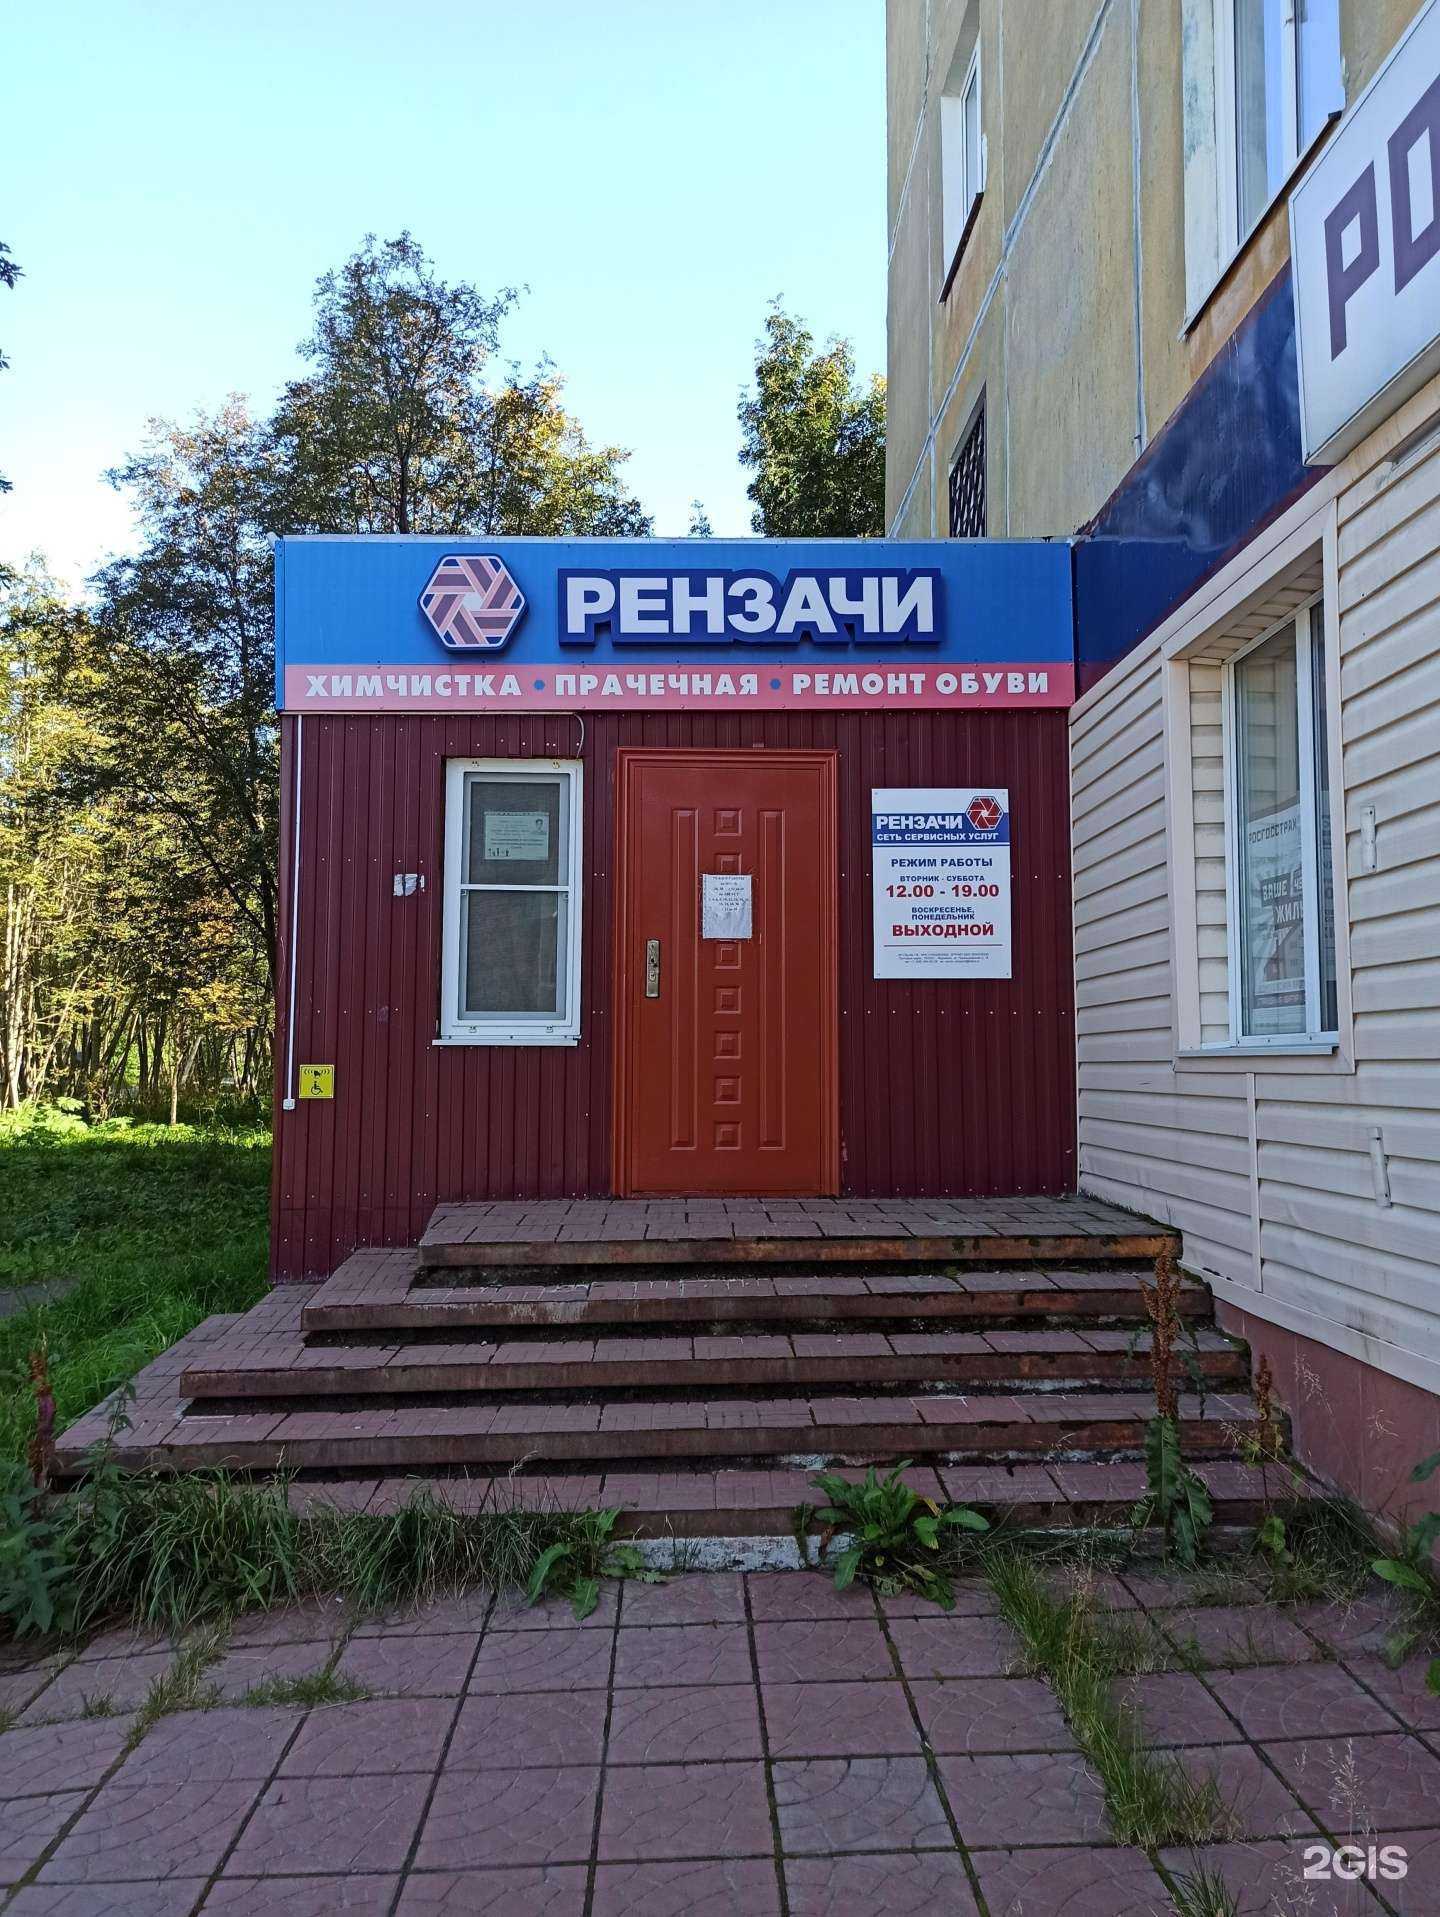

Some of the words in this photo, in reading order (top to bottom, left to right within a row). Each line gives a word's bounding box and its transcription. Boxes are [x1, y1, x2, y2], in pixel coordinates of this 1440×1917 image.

[566, 576, 934, 634] РЕНЗАЧИ
[305, 674, 522, 697] ХИМЧИСТКА
[554, 673, 758, 696] ПРАЧЕЧНАЯ
[792, 673, 925, 695] РЕМОНТ
[935, 672, 1048, 694] ОБУВИ
[876, 815, 963, 830] РЕНЗАЧИ
[876, 833, 902, 841] СЕТЬ
[904, 833, 966, 841] СЕРВИСНЫХ
[968, 832, 999, 840] УСЛУГ
[891, 858, 937, 868] РЕЖИМ
[940, 858, 993, 867] РАБОТЫ
[886, 885, 934, 898] 12.00
[951, 884, 1000, 897] 19.00
[892, 921, 994, 938] ВЫХОДНОЙ
